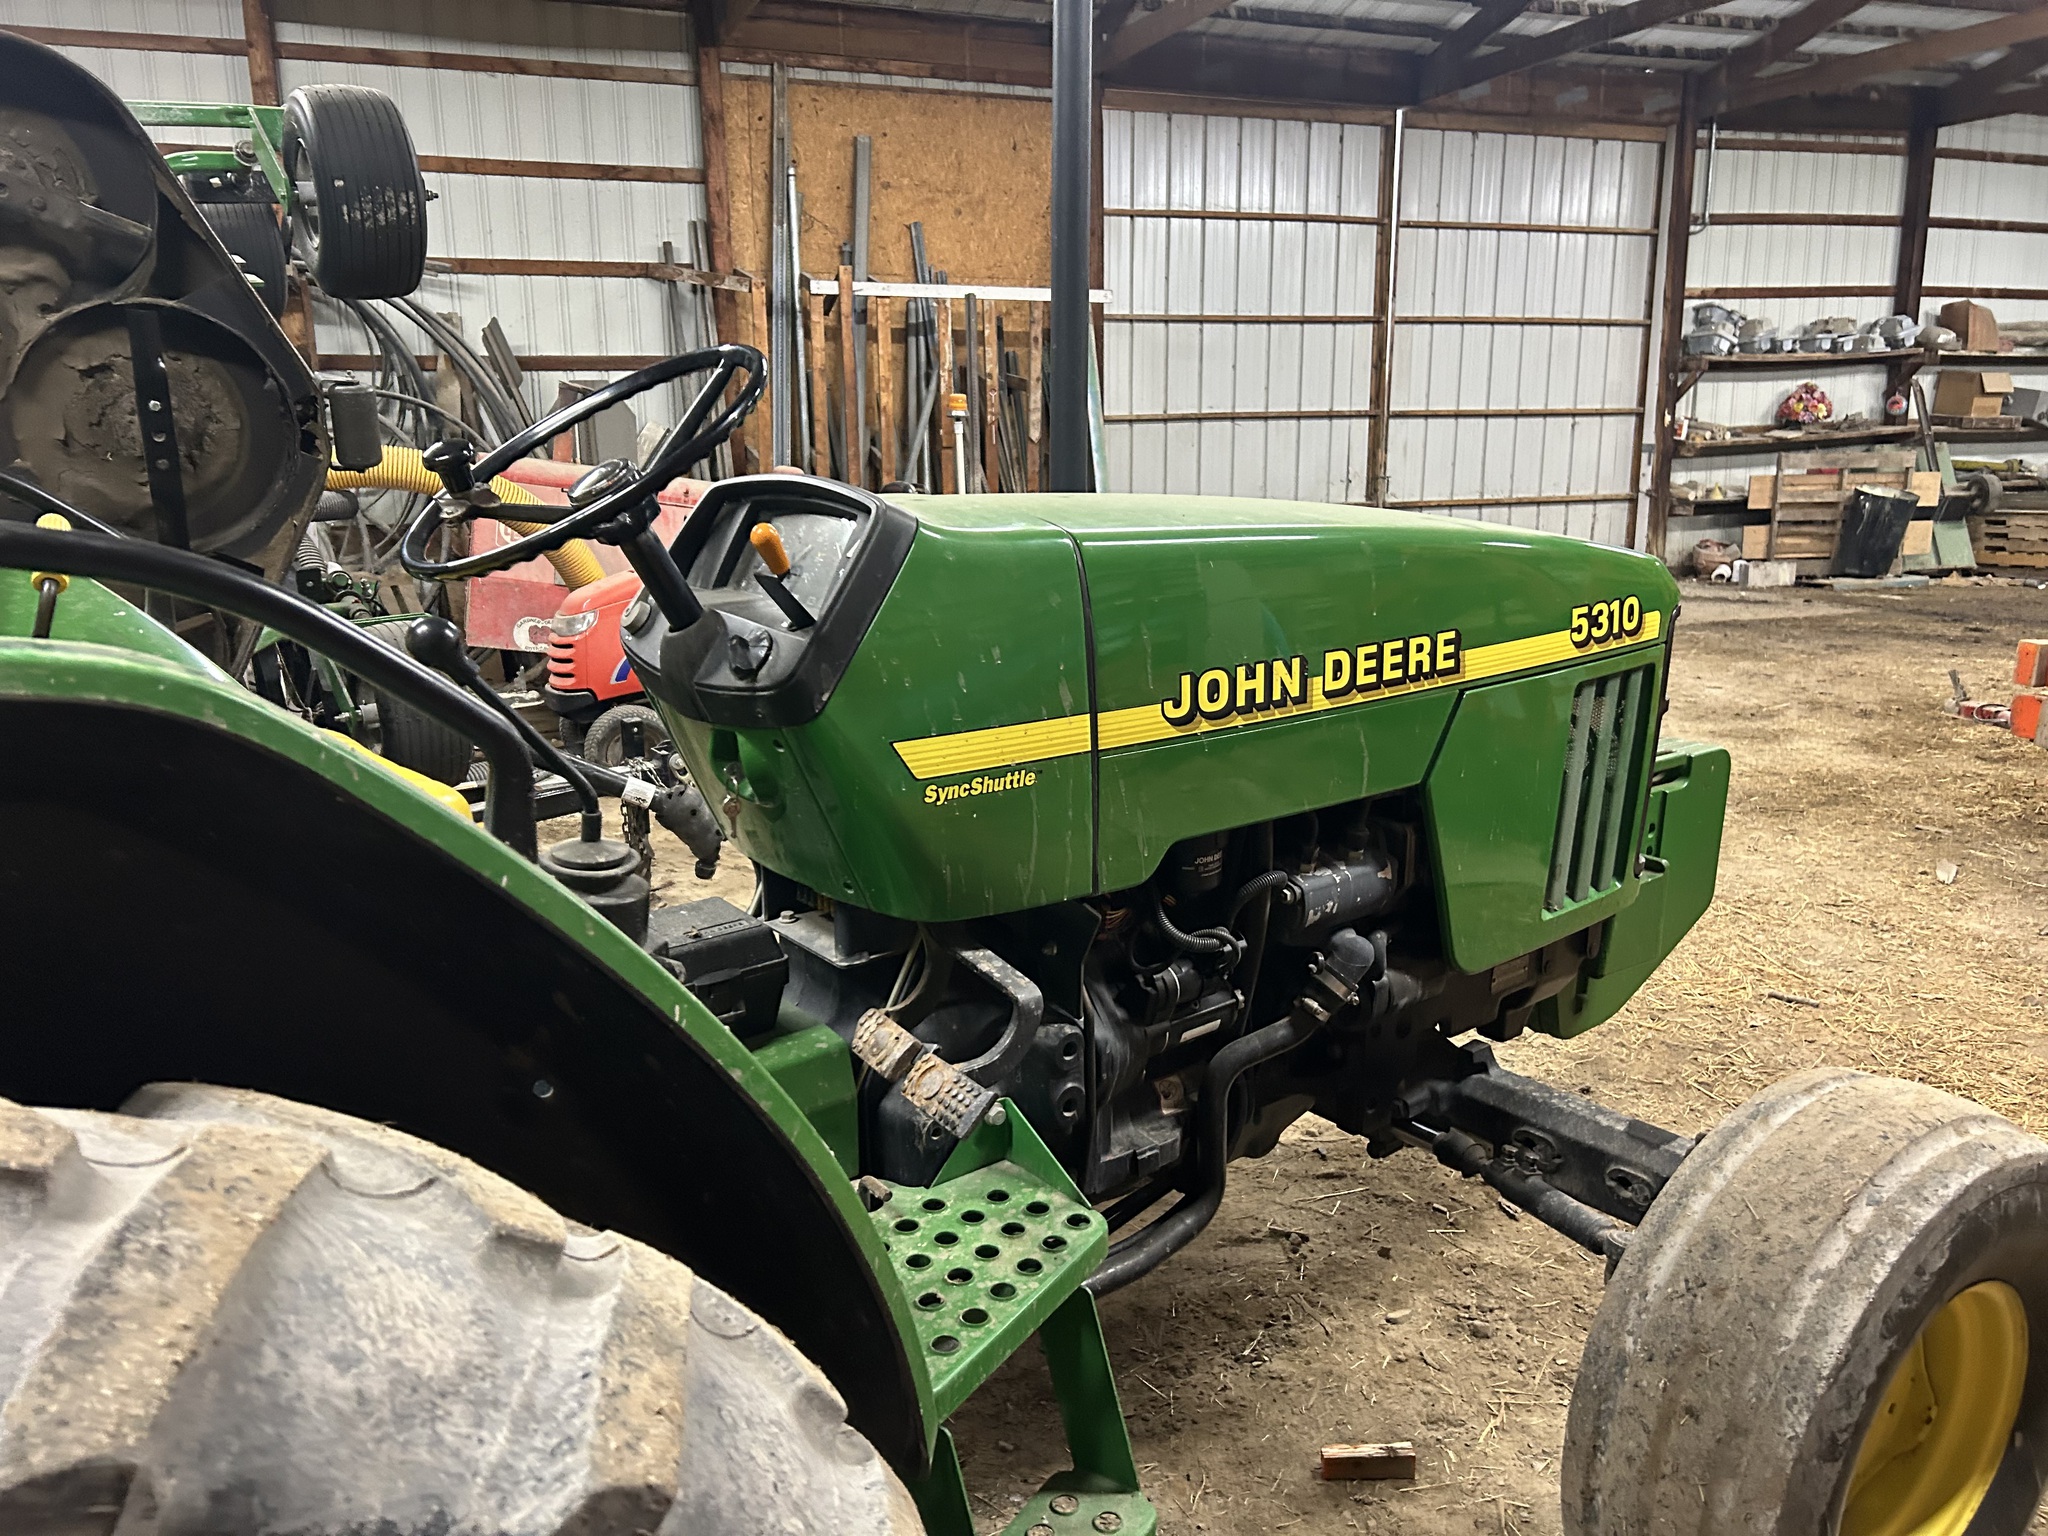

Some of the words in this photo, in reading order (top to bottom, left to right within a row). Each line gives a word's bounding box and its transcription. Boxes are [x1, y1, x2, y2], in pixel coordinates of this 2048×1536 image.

[1570, 594, 1642, 648] 5310
[1162, 655, 1307, 726] JOHN
[1322, 629, 1462, 698] DEERE
[923, 769, 1037, 806] SyncShuttle
[1194, 855, 1213, 864] JOHN
